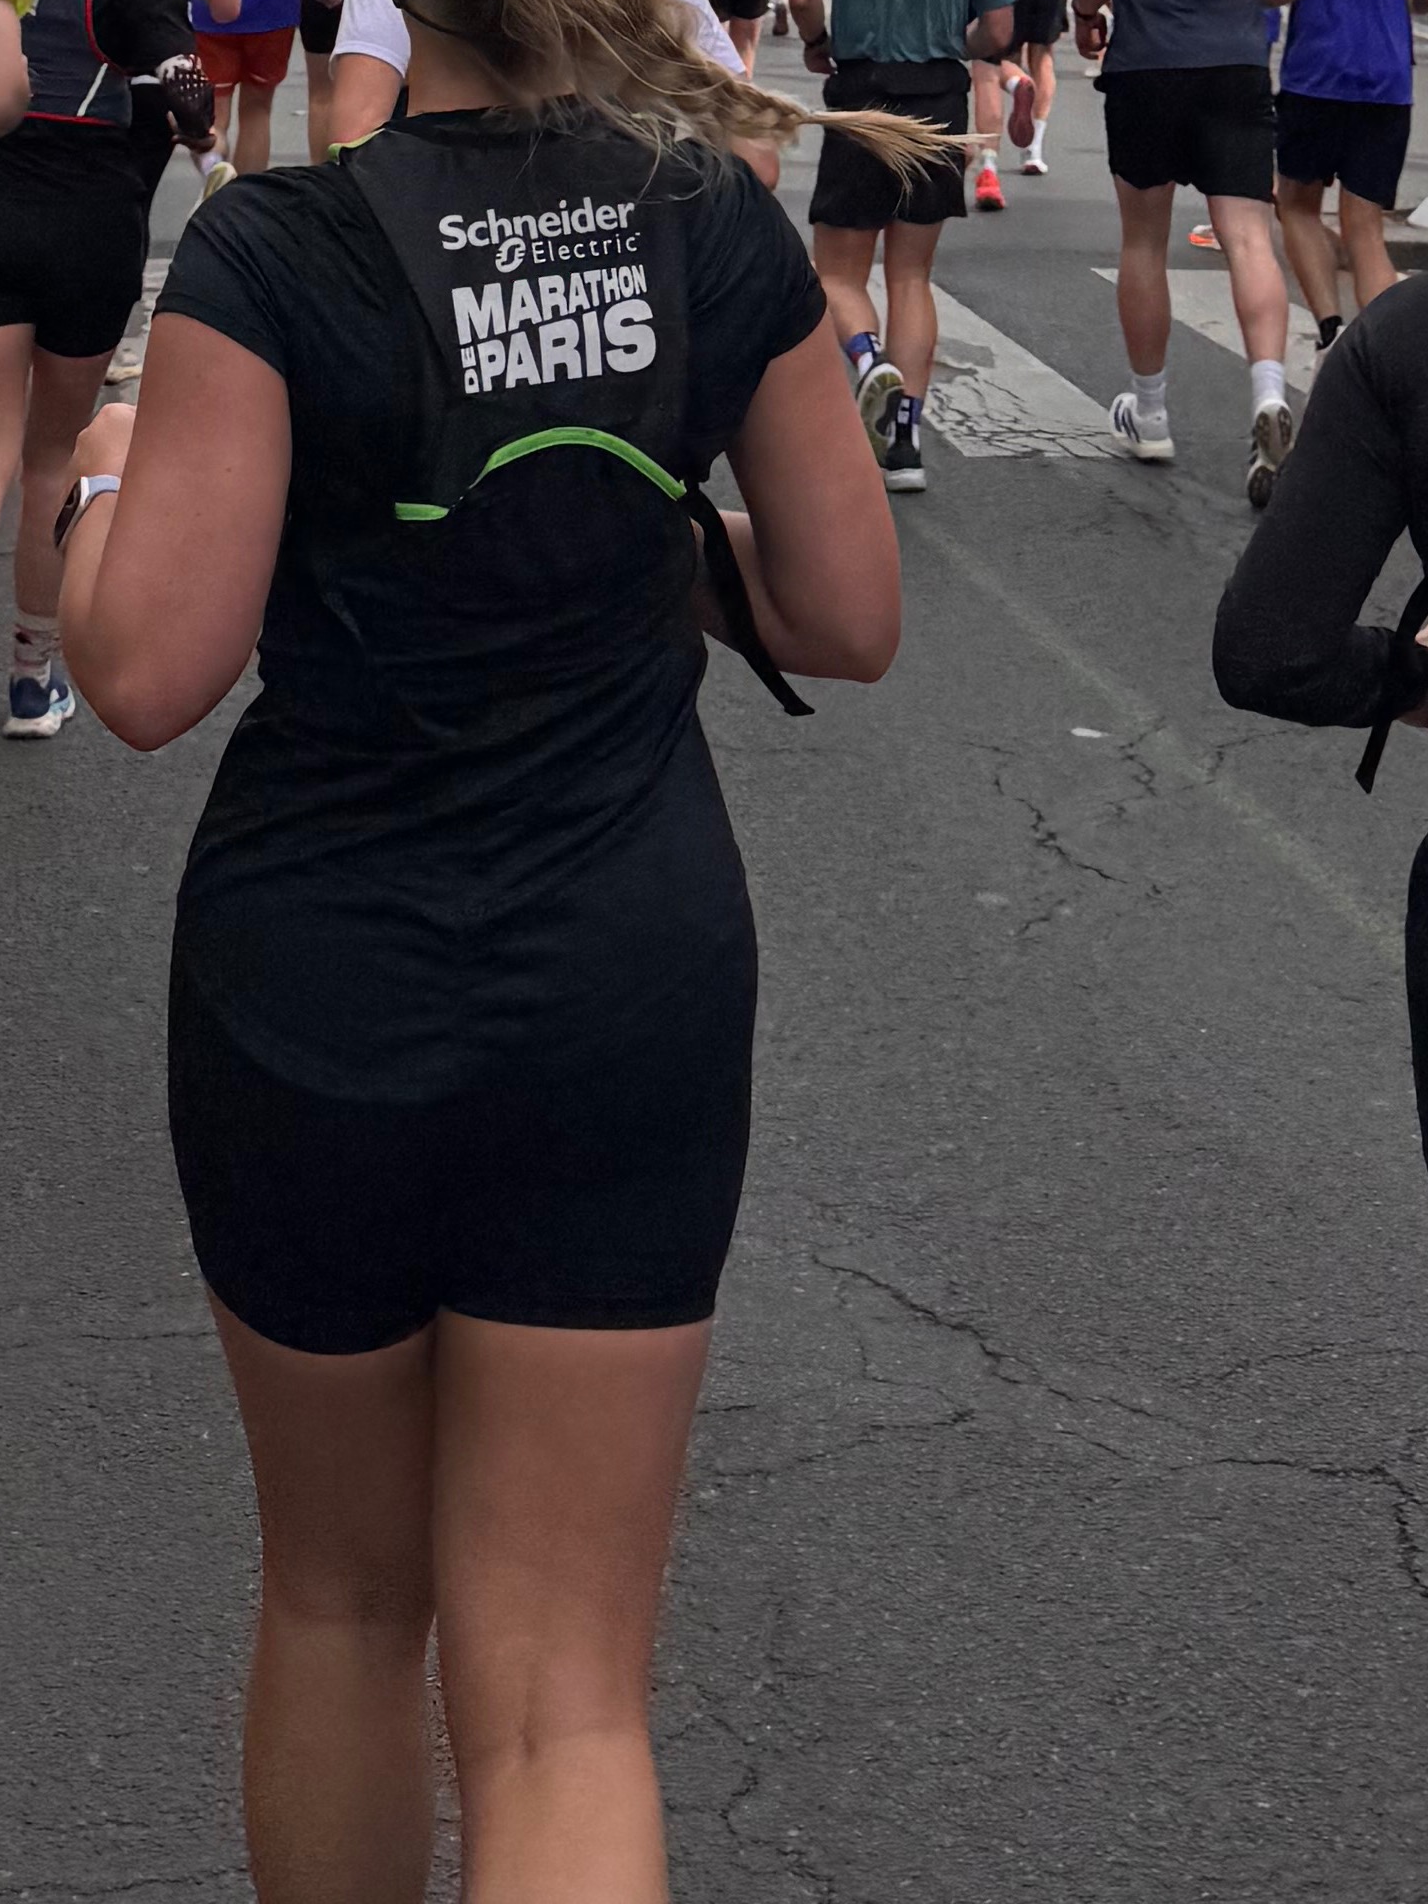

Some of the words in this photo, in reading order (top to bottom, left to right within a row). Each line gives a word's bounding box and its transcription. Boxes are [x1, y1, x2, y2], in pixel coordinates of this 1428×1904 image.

[439, 196, 635, 251] Schneider
[532, 233, 639, 264] Electric
[452, 264, 647, 345] MARATHON
[460, 345, 479, 394] DE
[478, 298, 657, 392] PARIS
